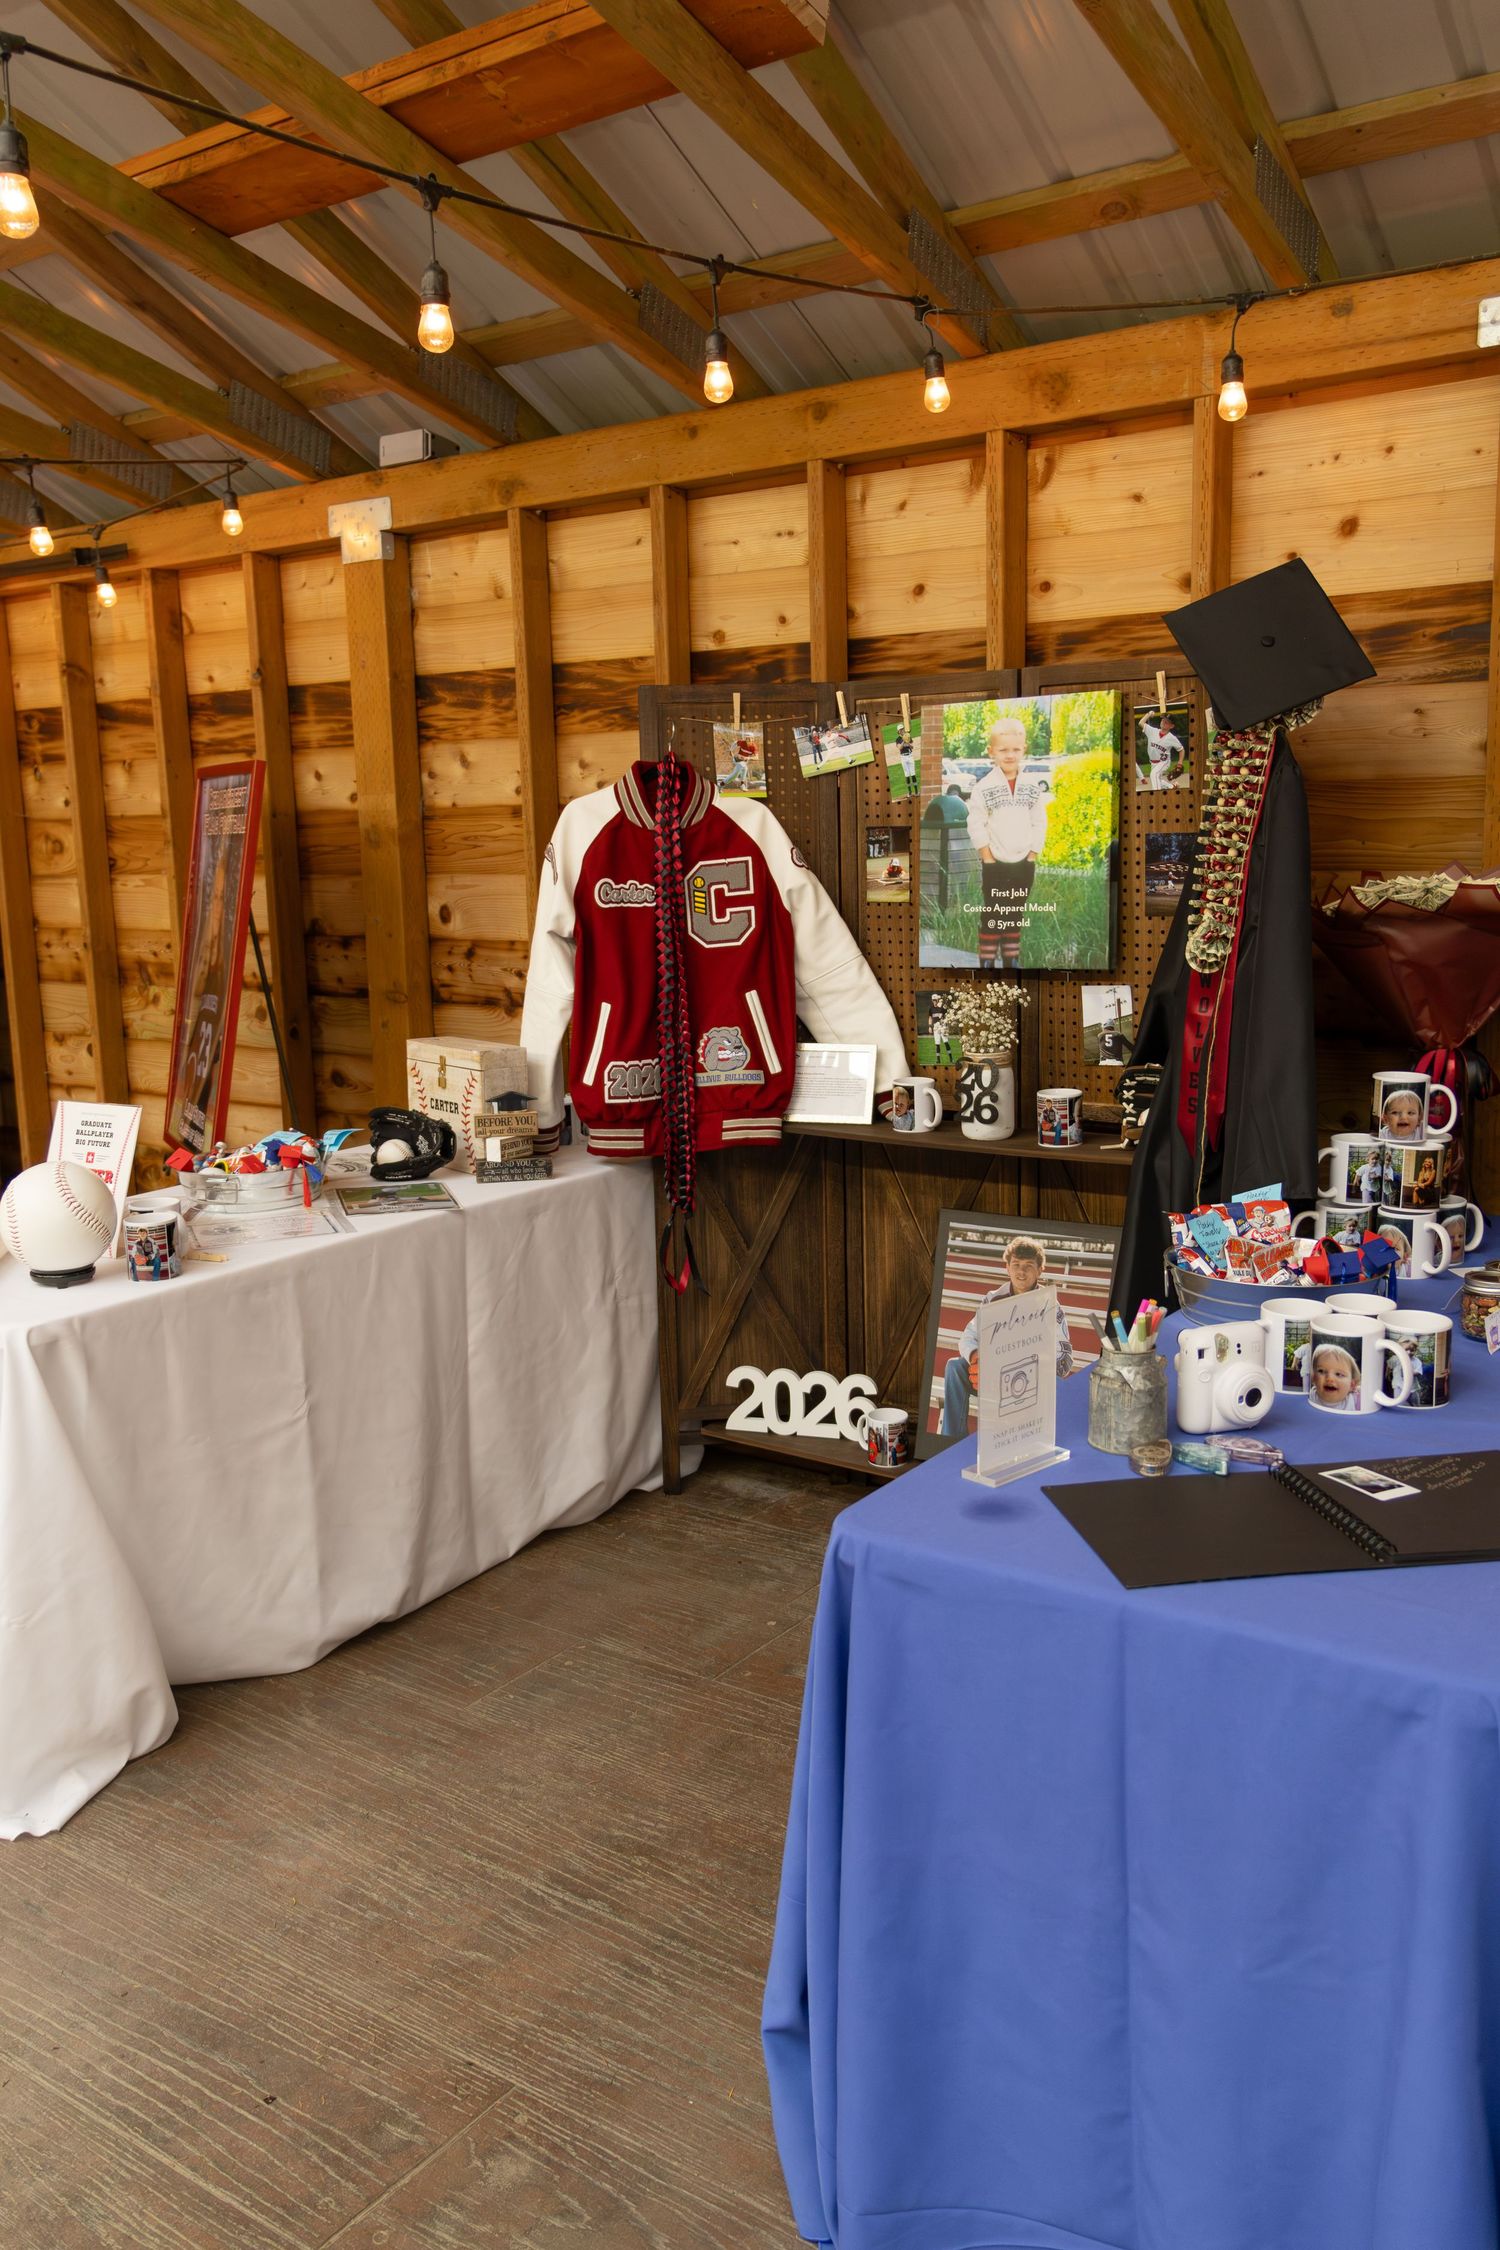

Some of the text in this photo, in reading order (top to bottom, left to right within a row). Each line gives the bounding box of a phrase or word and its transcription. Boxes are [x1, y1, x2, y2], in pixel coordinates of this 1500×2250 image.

[598, 881, 656, 904] Carter
[991, 888, 1028, 899] First Job!
[683, 855, 755, 948] C
[963, 903, 1057, 915] Costco Apparel Model
[987, 918, 1030, 930] @ 5yrs old
[1104, 1034, 1113, 1047] 5
[1188, 973, 1212, 1114] WOLVES
[696, 1073, 762, 1084] ELLEVUE BULLDOGS
[430, 1097, 459, 1114] CARTER
[80, 1120, 112, 1129] GRADUATE
[477, 1116, 513, 1127] BEFORE
[75, 1129, 114, 1139] BALLPLAYER
[75, 1138, 111, 1148] BIG FUTURE
[986, 1299, 1052, 1345] polaroid
[995, 1334, 1042, 1355] GUESTBOOK
[725, 1365, 878, 1442] 2026
